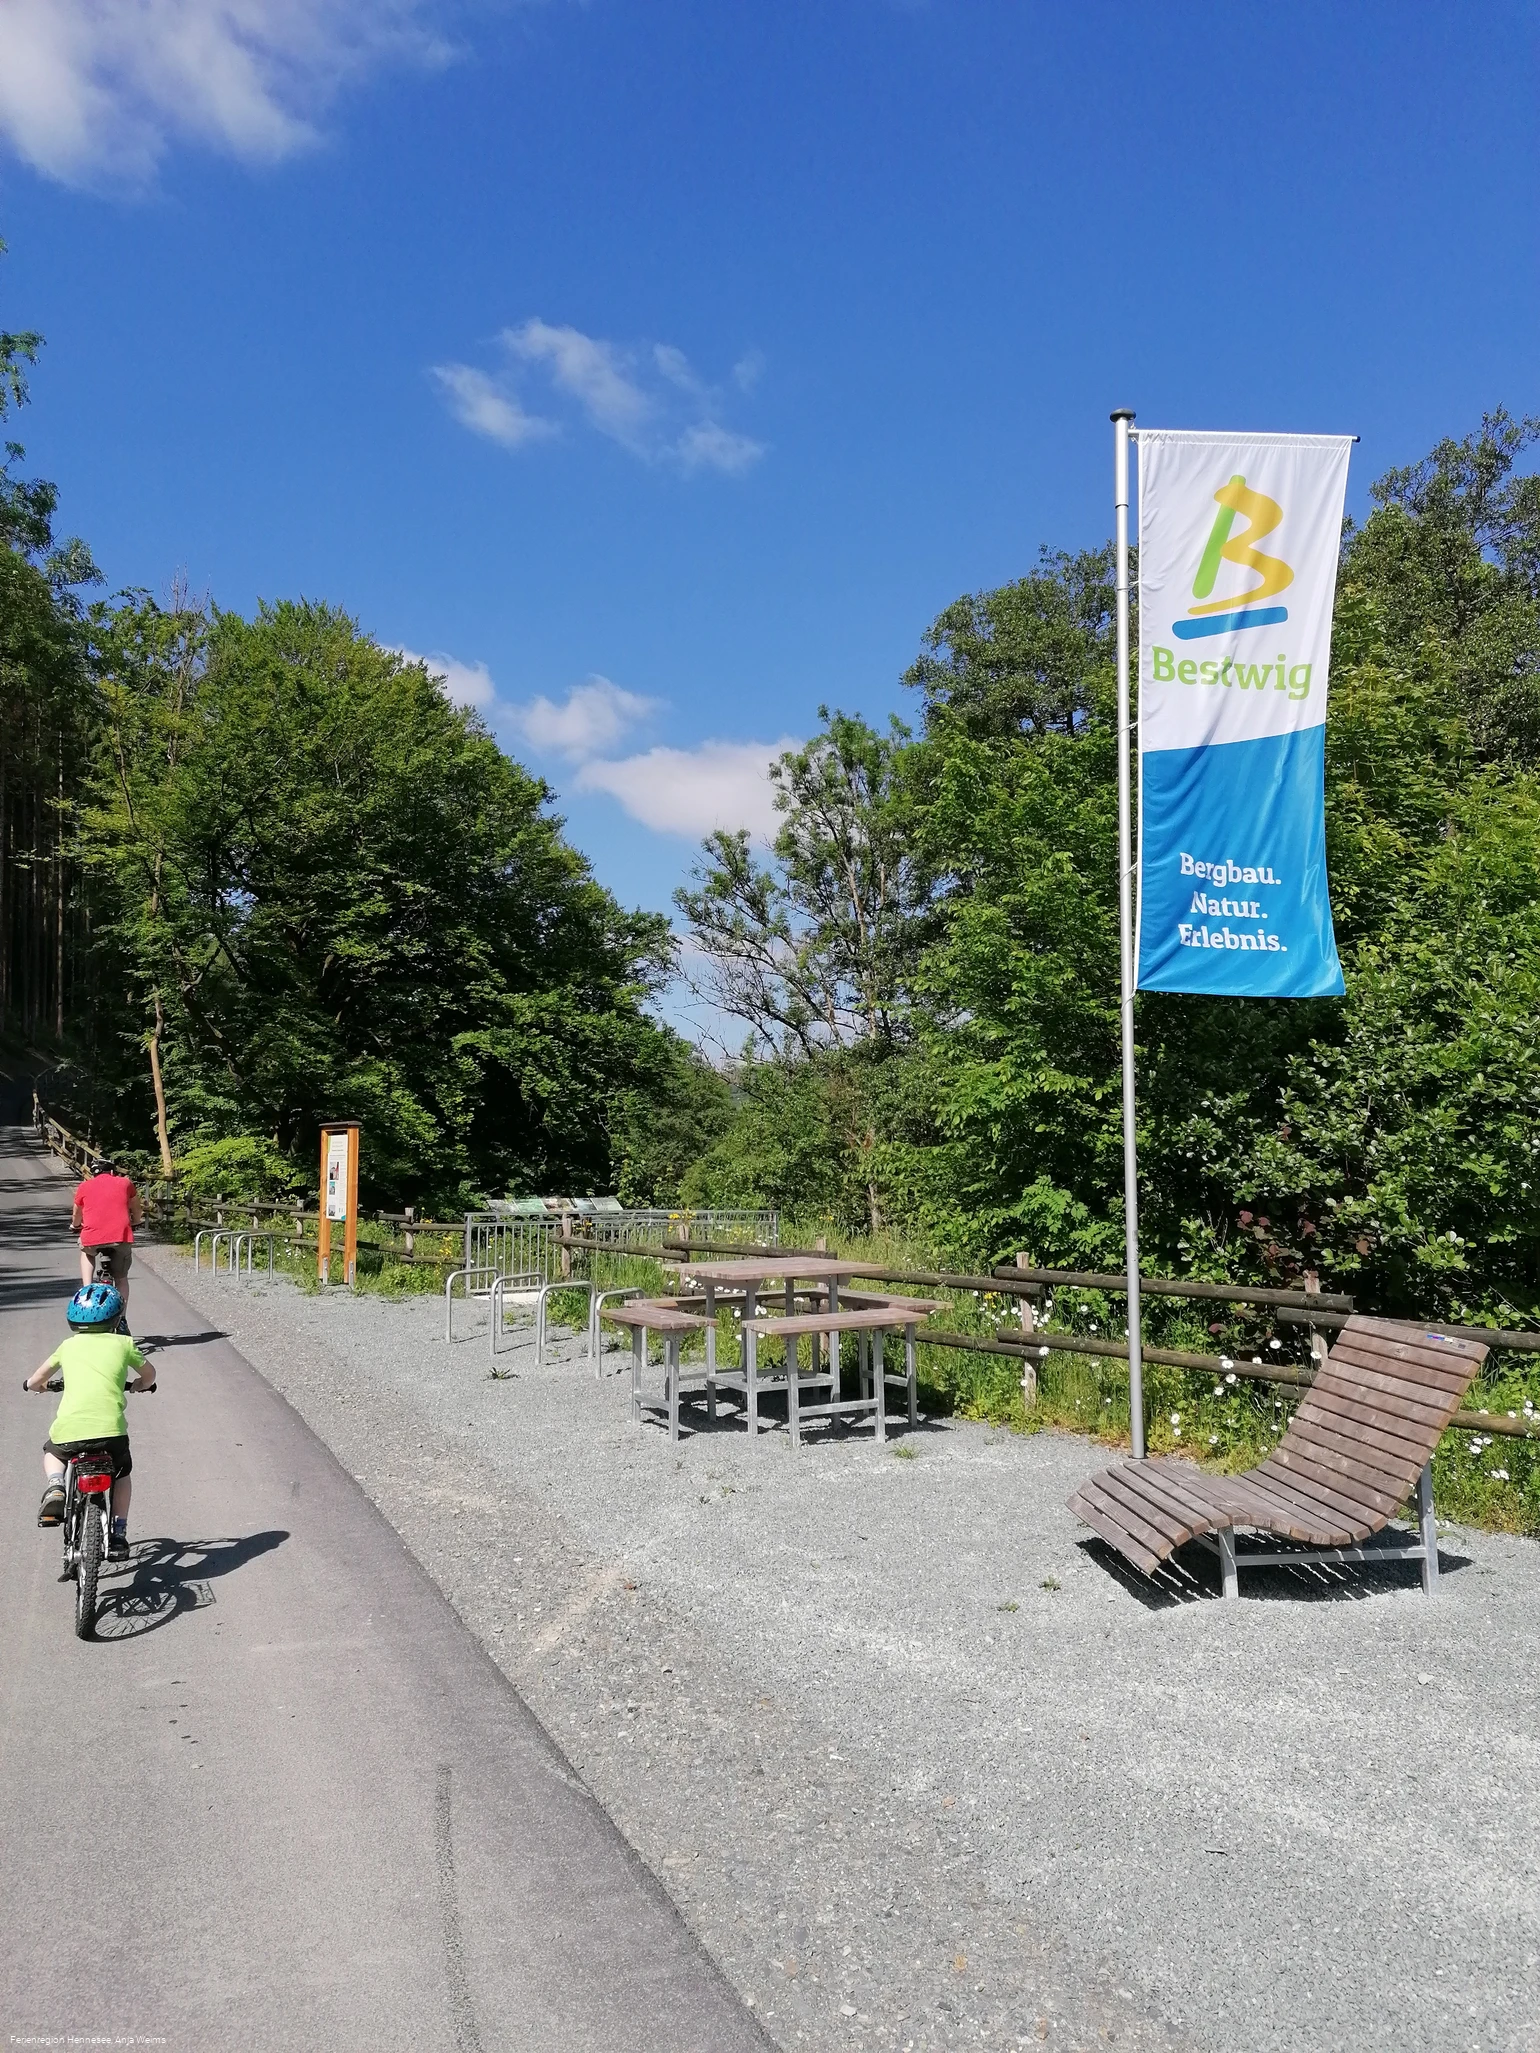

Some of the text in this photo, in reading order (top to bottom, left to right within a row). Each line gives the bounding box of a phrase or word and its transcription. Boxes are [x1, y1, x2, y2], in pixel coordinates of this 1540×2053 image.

[1152, 645, 1312, 701] Bestwig
[1180, 852, 1282, 887] Bergbau.
[1190, 891, 1268, 919] Natur.
[1178, 923, 1288, 952] Erlebnis.
